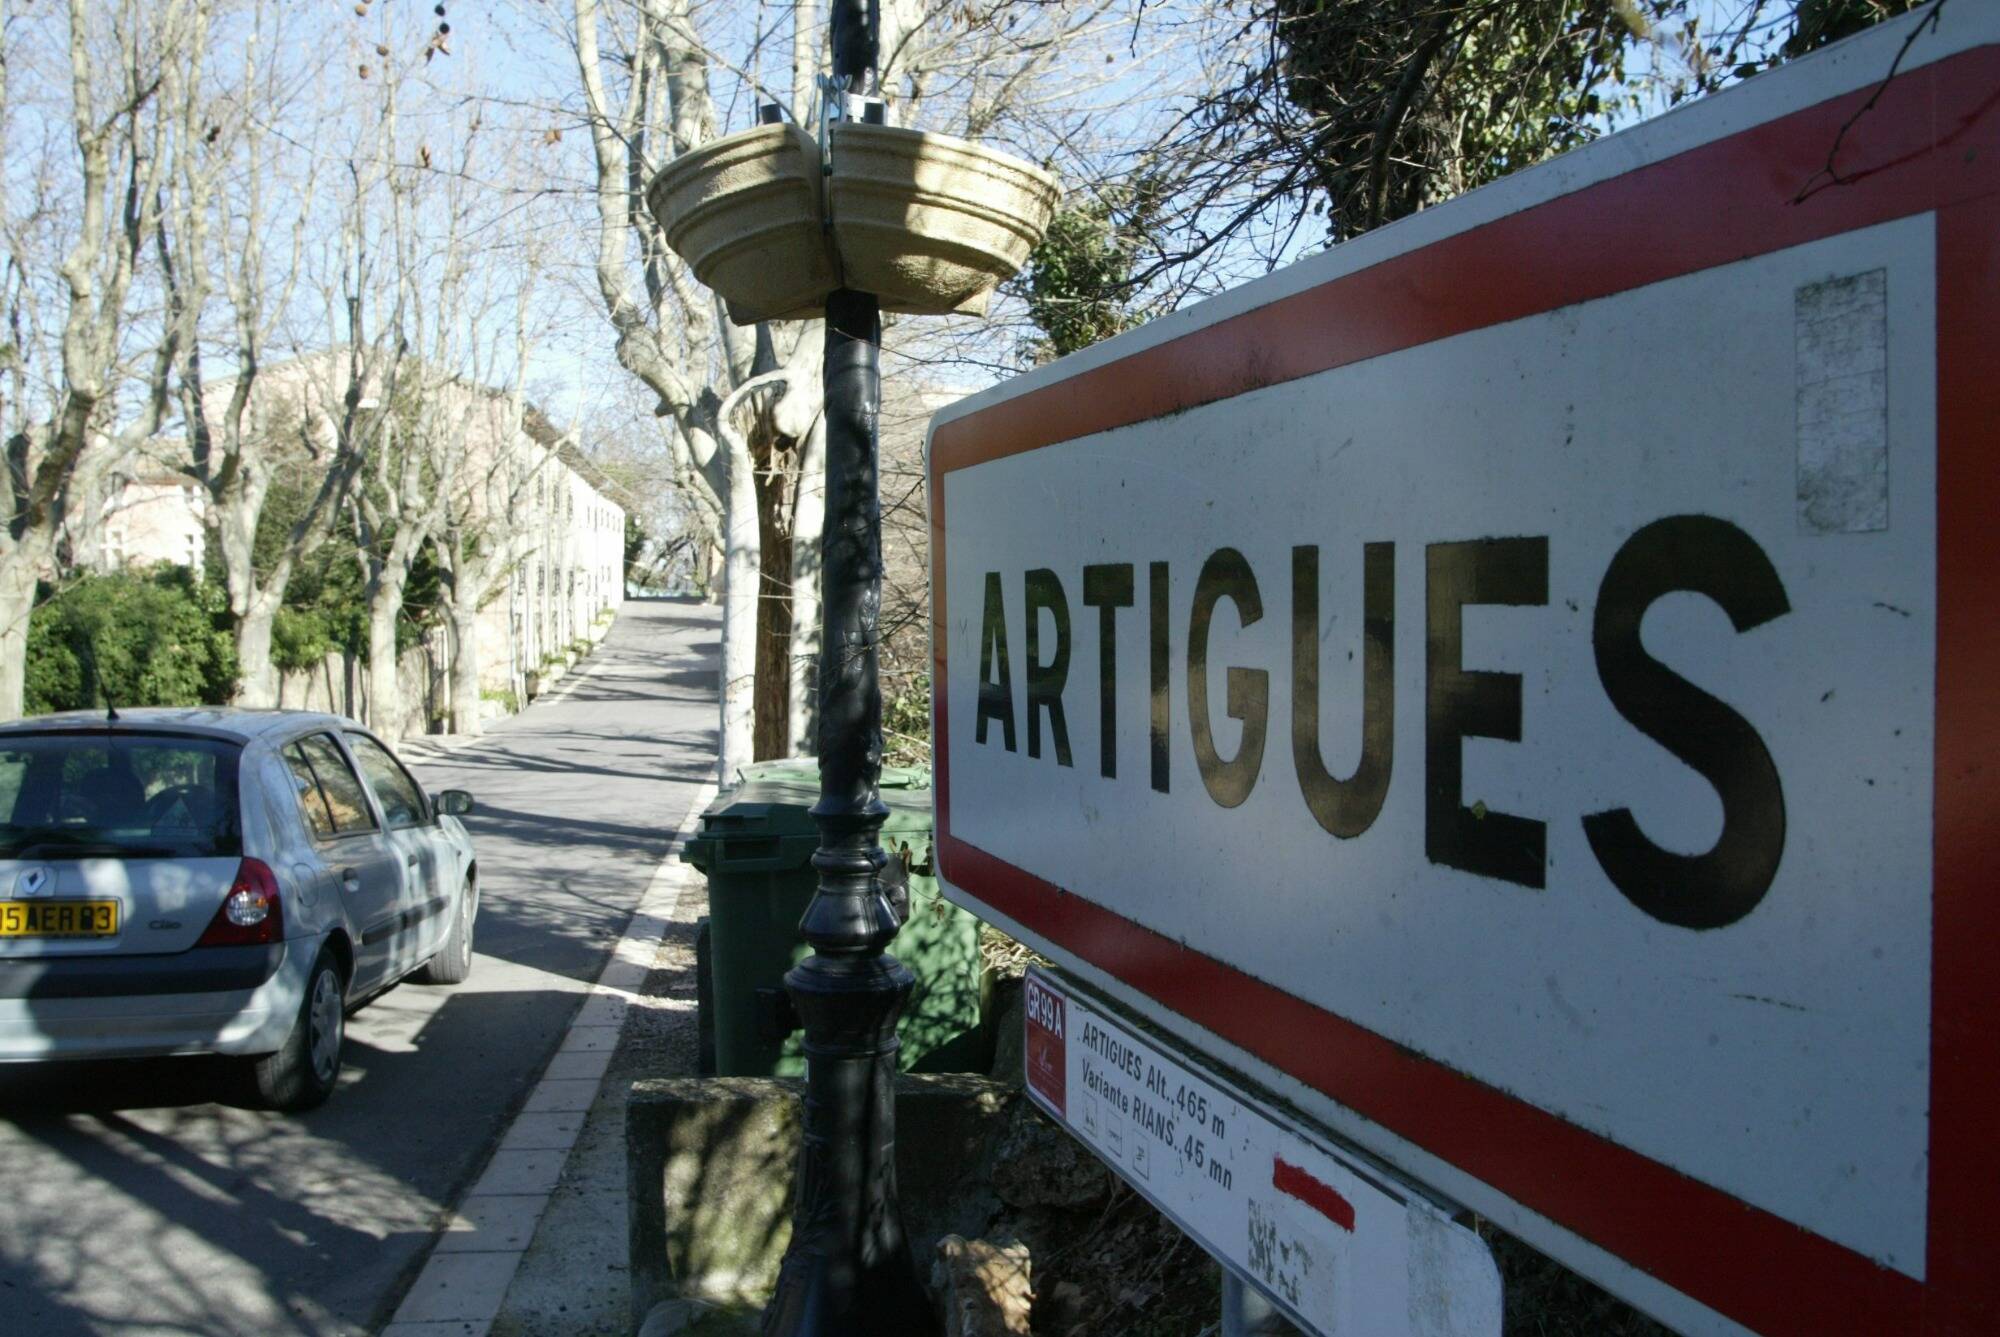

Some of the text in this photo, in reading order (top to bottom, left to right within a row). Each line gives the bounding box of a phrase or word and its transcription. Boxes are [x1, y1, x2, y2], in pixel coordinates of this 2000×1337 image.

[976, 514, 1793, 930] ARTIGUES
[0, 907, 20, 931] 5
[1082, 1058, 1128, 1113] Variante
[1209, 1158, 1232, 1191] mn
[1083, 1021, 1143, 1082] ARTIGUES
[1212, 1113, 1225, 1140] m
